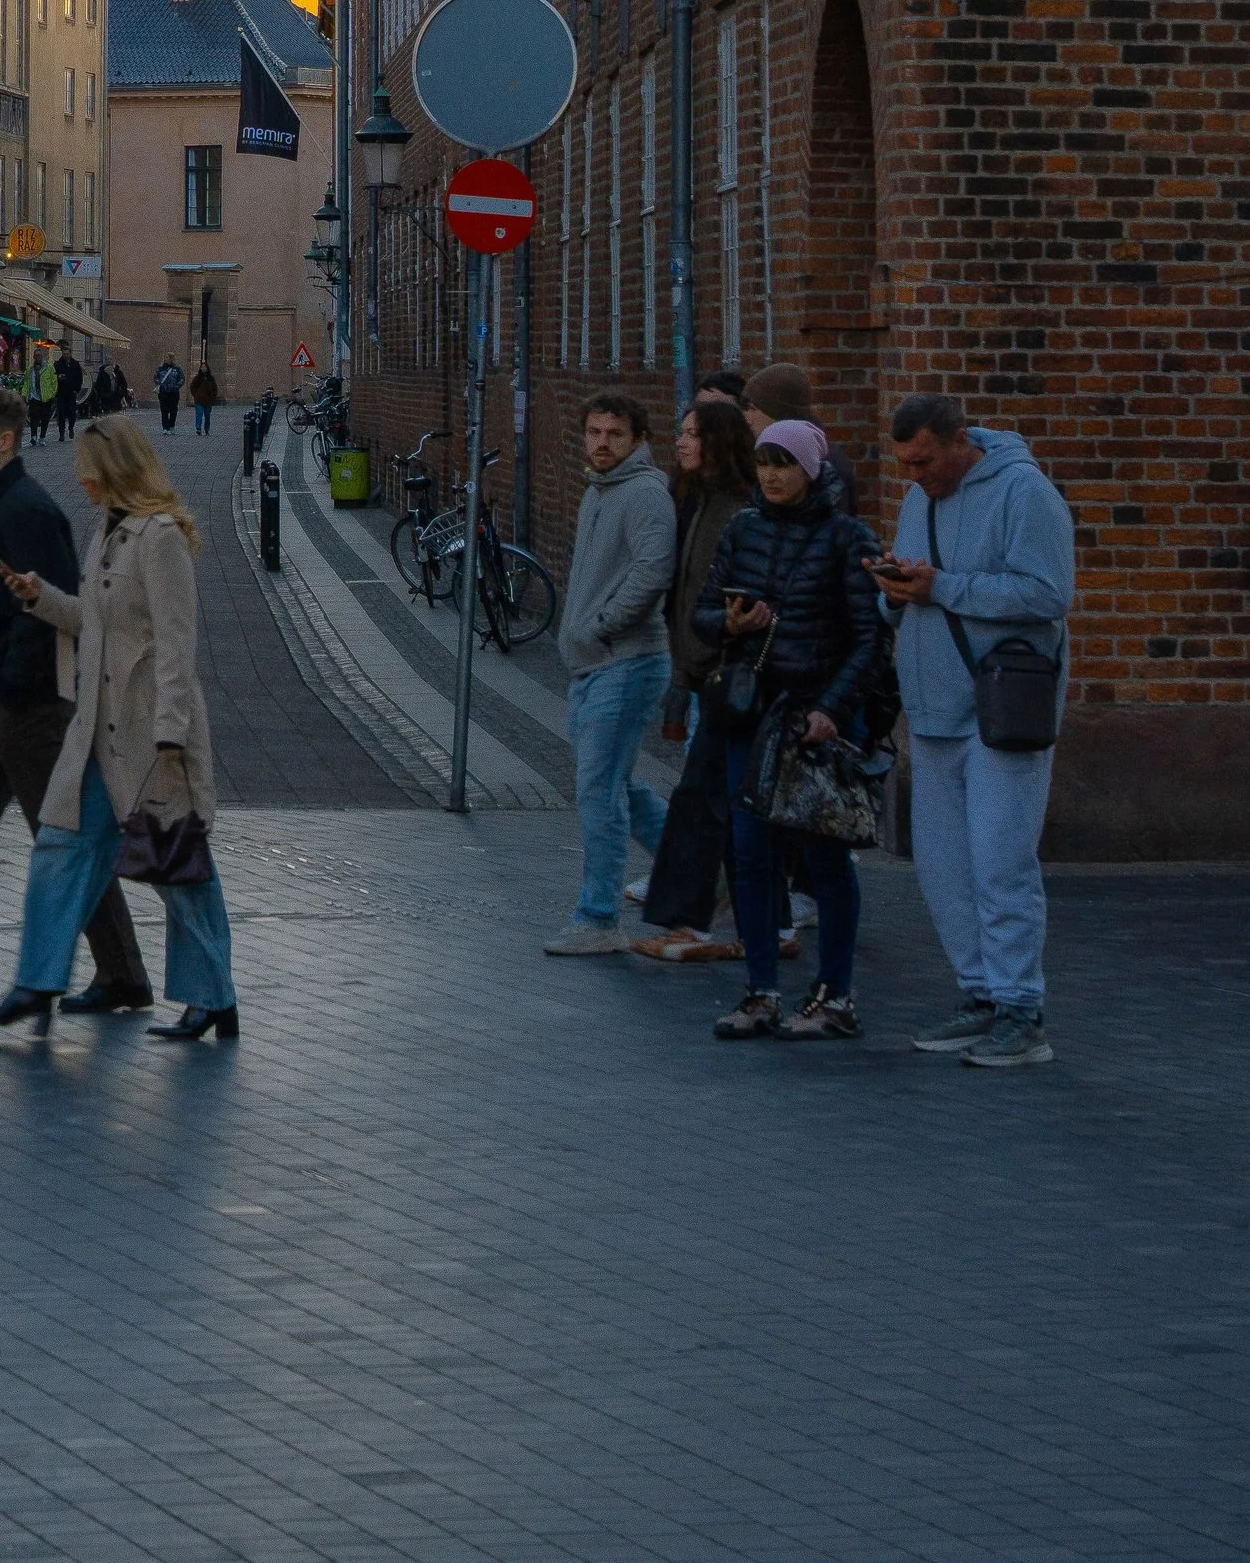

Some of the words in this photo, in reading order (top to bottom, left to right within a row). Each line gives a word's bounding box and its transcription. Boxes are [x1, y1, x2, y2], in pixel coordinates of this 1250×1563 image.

[242, 126, 293, 144] memira
[17, 228, 36, 240] RIZ
[17, 239, 36, 251] RAZ
